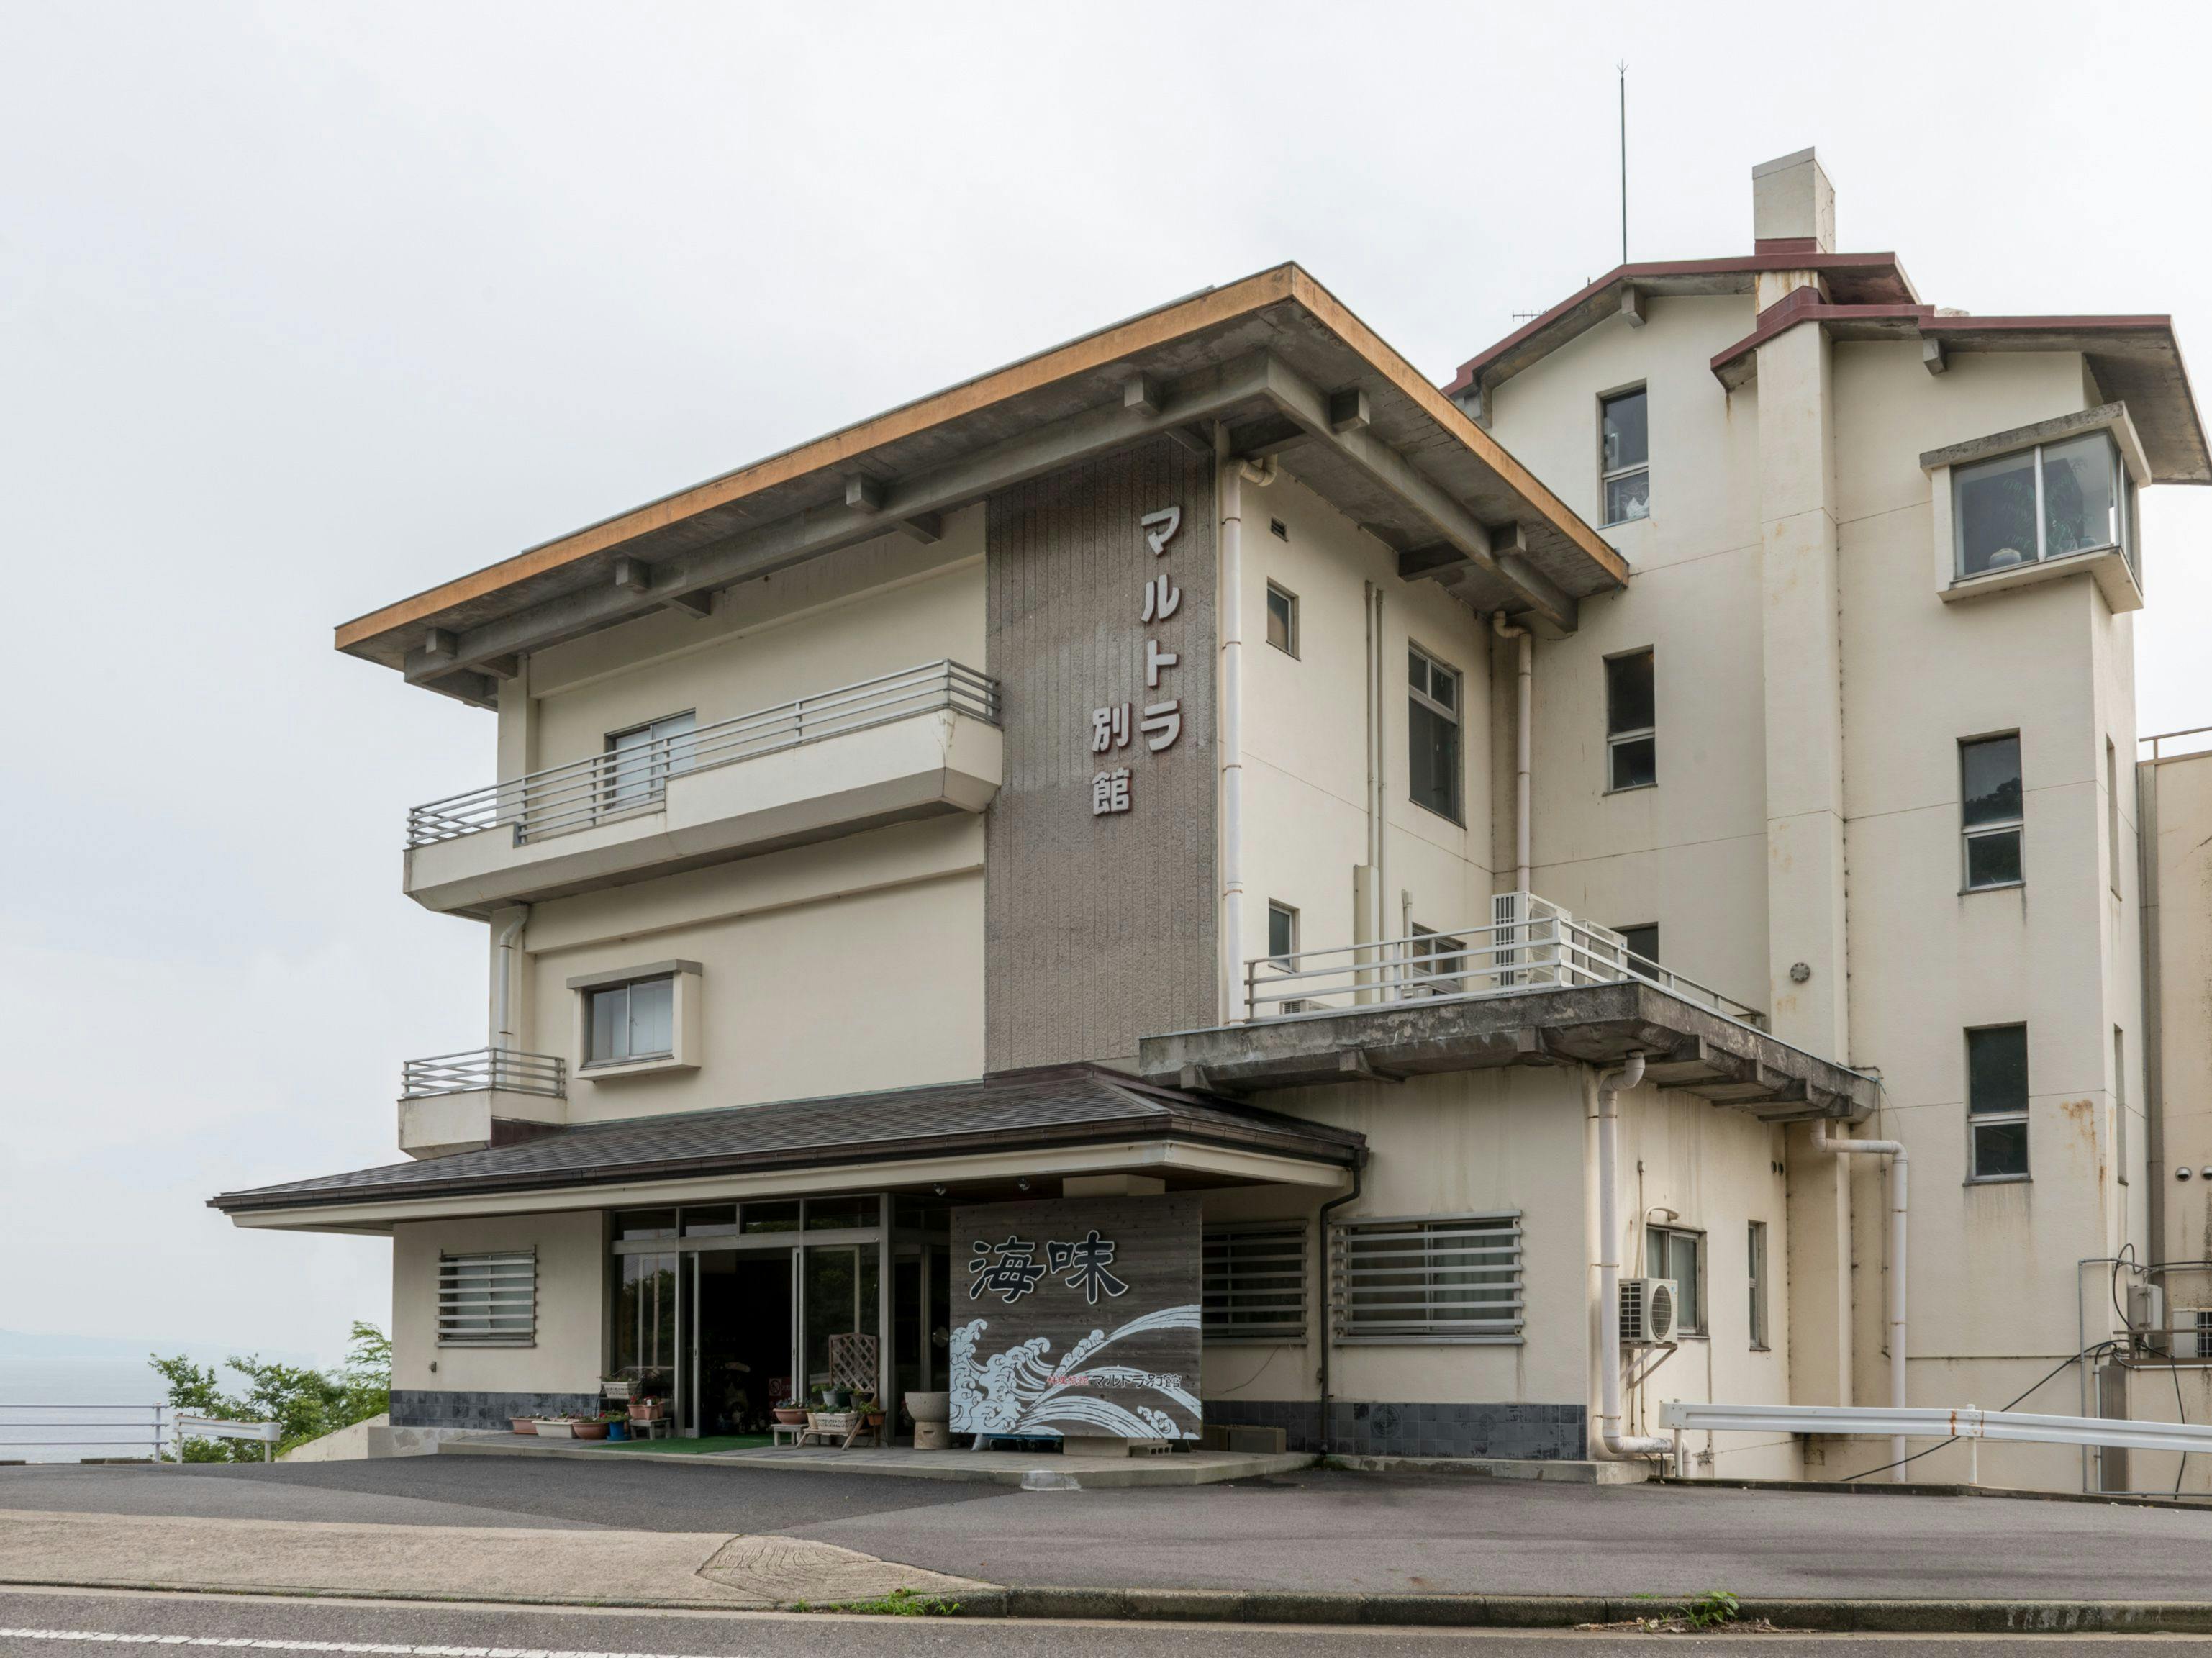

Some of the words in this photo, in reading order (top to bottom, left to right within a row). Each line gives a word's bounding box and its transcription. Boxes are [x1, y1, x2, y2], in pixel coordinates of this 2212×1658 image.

[1141, 506, 1182, 752] マルトラ
[1092, 702, 1132, 816] 別館
[969, 1230, 1128, 1305] 海味
[1092, 1373, 1182, 1389] マルトラ別館
